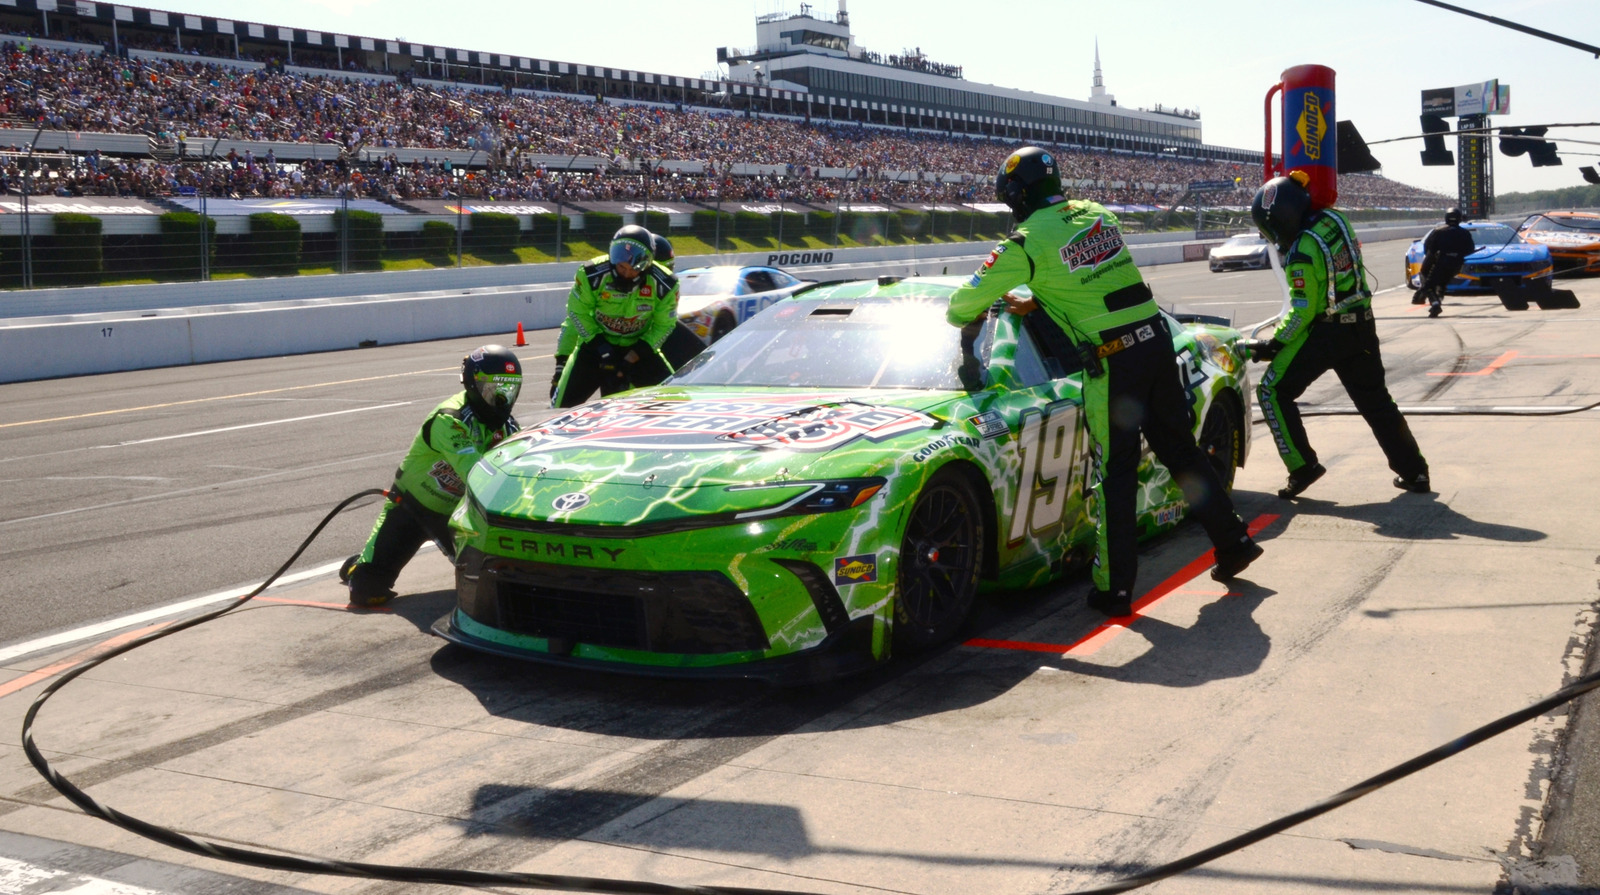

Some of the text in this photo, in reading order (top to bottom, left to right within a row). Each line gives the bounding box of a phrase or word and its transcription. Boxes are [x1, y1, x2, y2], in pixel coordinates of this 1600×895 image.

[1306, 93, 1319, 159] SUNOCO
[1064, 227, 1120, 258] INTERSTATE
[1071, 239, 1123, 267] BATTERIES
[767, 252, 833, 266] POCONO
[101, 327, 113, 337] 17
[1008, 402, 1078, 543] 19
[498, 536, 626, 561] CAMRY
[838, 565, 874, 576] SUNOCO
